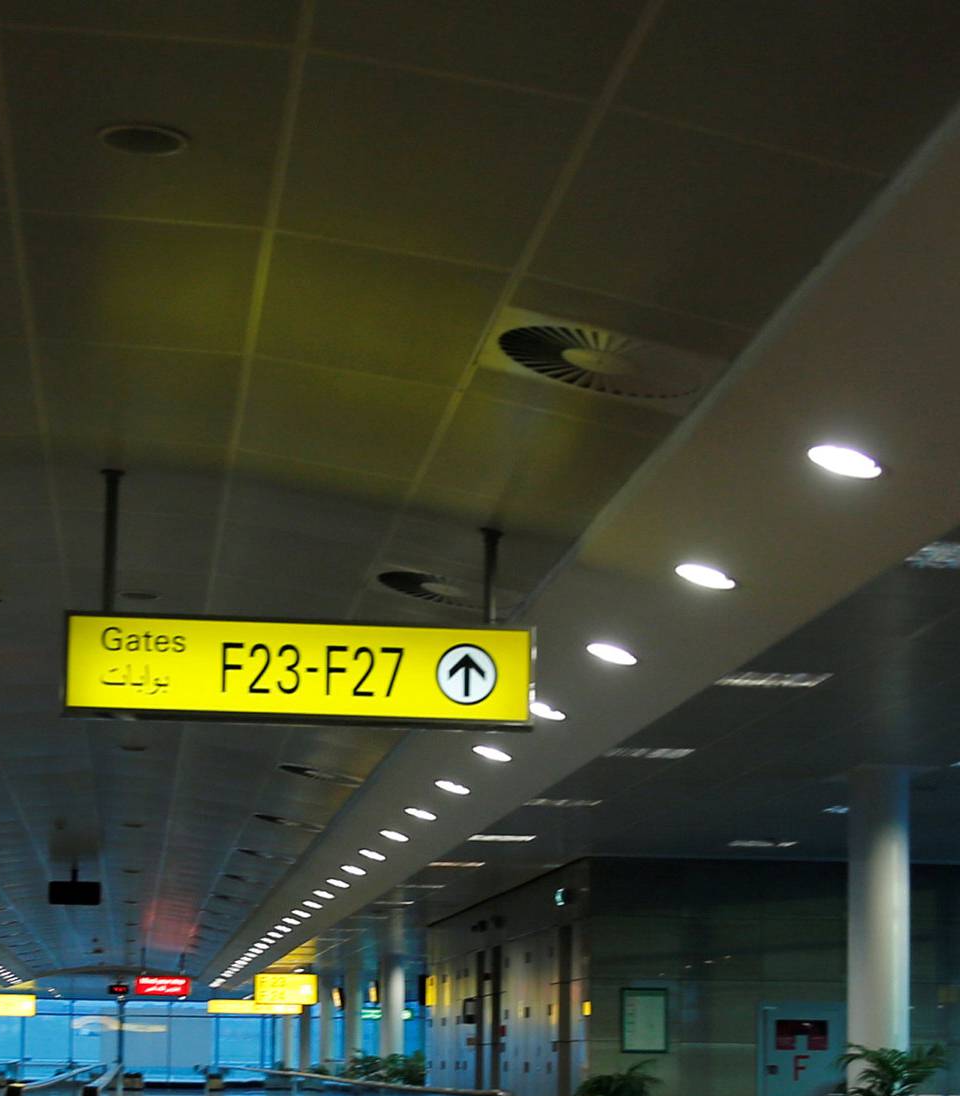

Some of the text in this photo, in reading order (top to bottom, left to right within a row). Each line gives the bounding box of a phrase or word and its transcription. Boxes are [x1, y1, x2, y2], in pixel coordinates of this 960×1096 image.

[100, 626, 187, 653] Gates
[98, 664, 170, 696] بوابات
[221, 641, 405, 698] F23-F27
[793, 1055, 810, 1081] F
